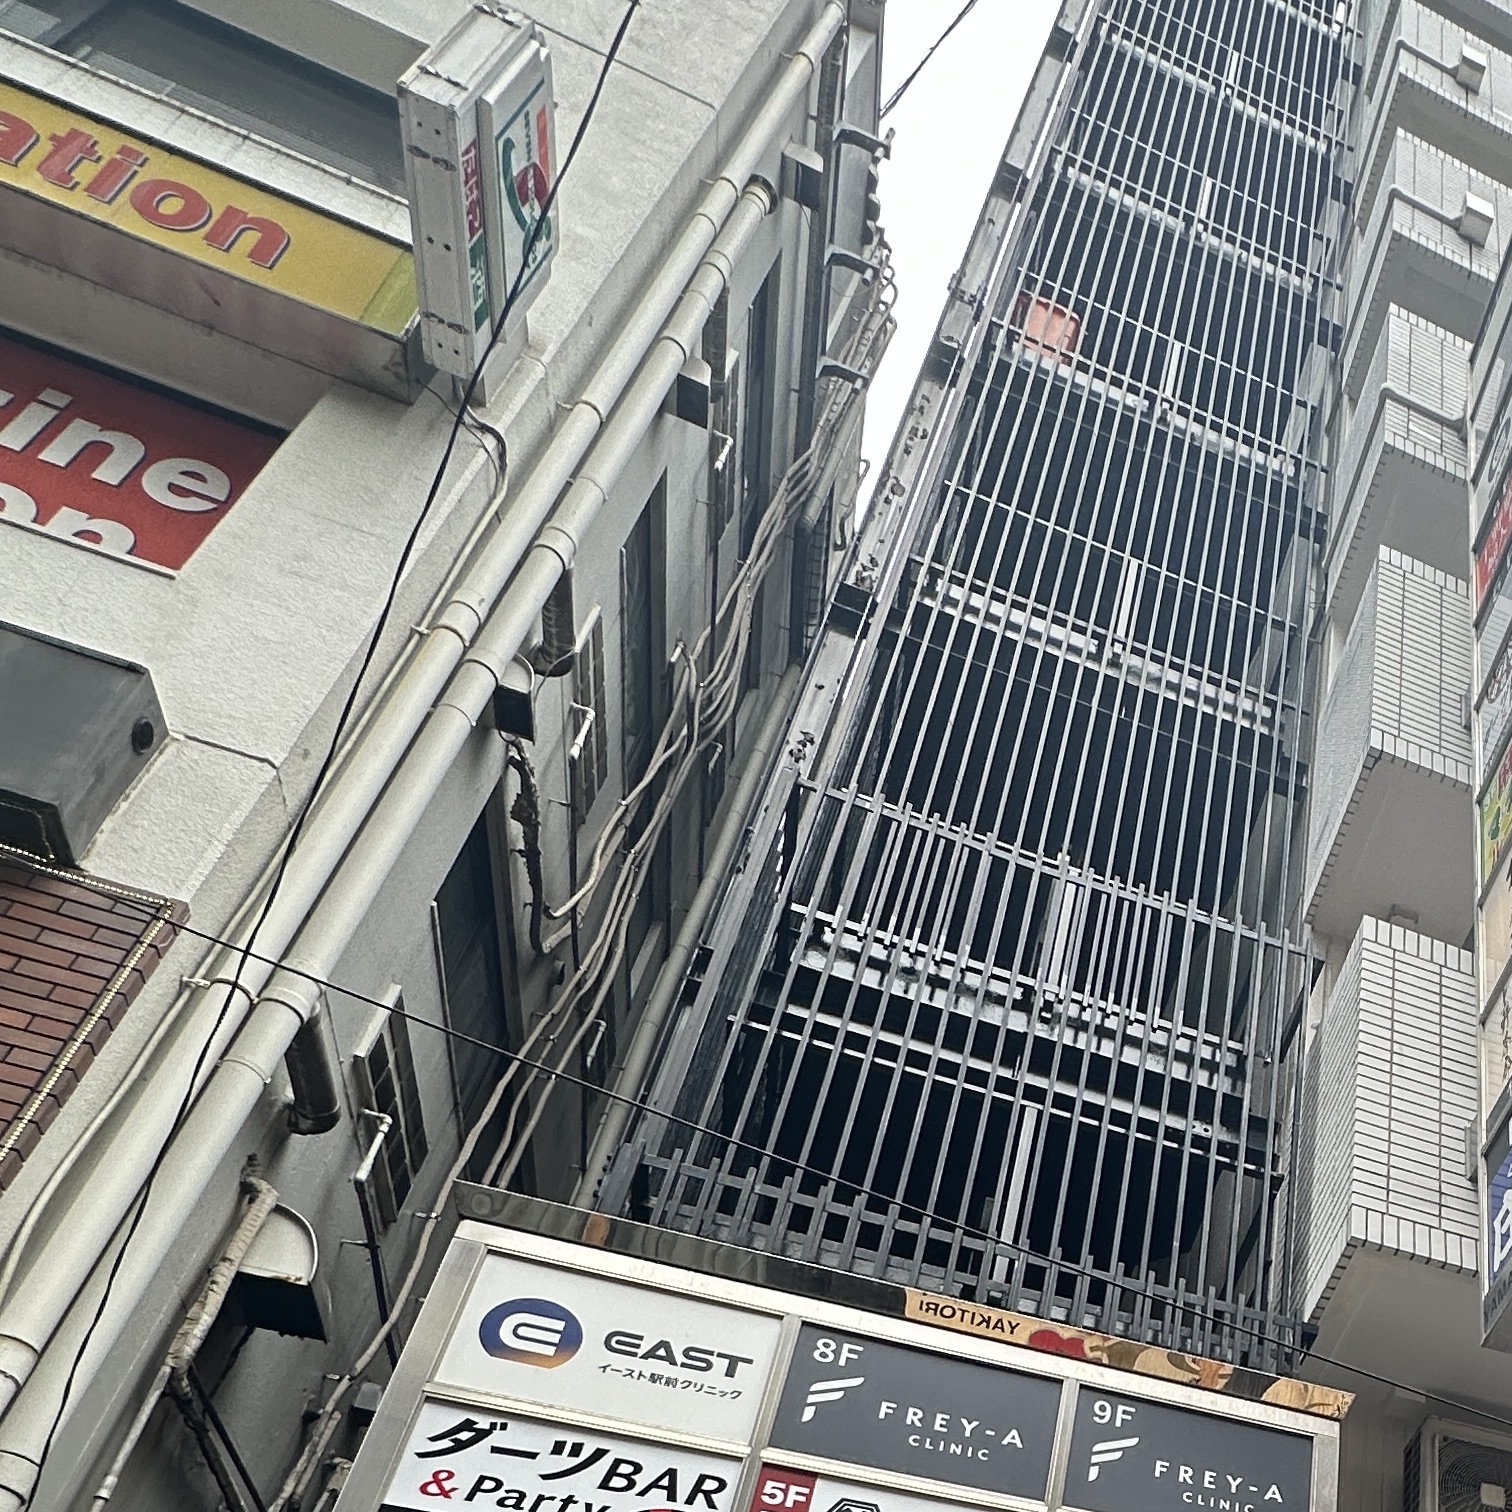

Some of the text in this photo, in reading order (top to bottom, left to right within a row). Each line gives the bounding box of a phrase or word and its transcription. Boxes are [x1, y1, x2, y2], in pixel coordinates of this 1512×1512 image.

[0, 387, 231, 513] ine
[604, 1330, 753, 1378] EAST
[813, 1338, 863, 1367] 8F
[598, 1363, 743, 1399] イースト駅前クリニック
[878, 1400, 1023, 1449] FREY-A
[1092, 1400, 1137, 1428] 9F
[414, 1417, 727, 1510] ダーツBAR
[908, 1434, 990, 1461] CLINIC
[761, 1480, 810, 1508] 5F
[1154, 1460, 1283, 1503] FREY-A
